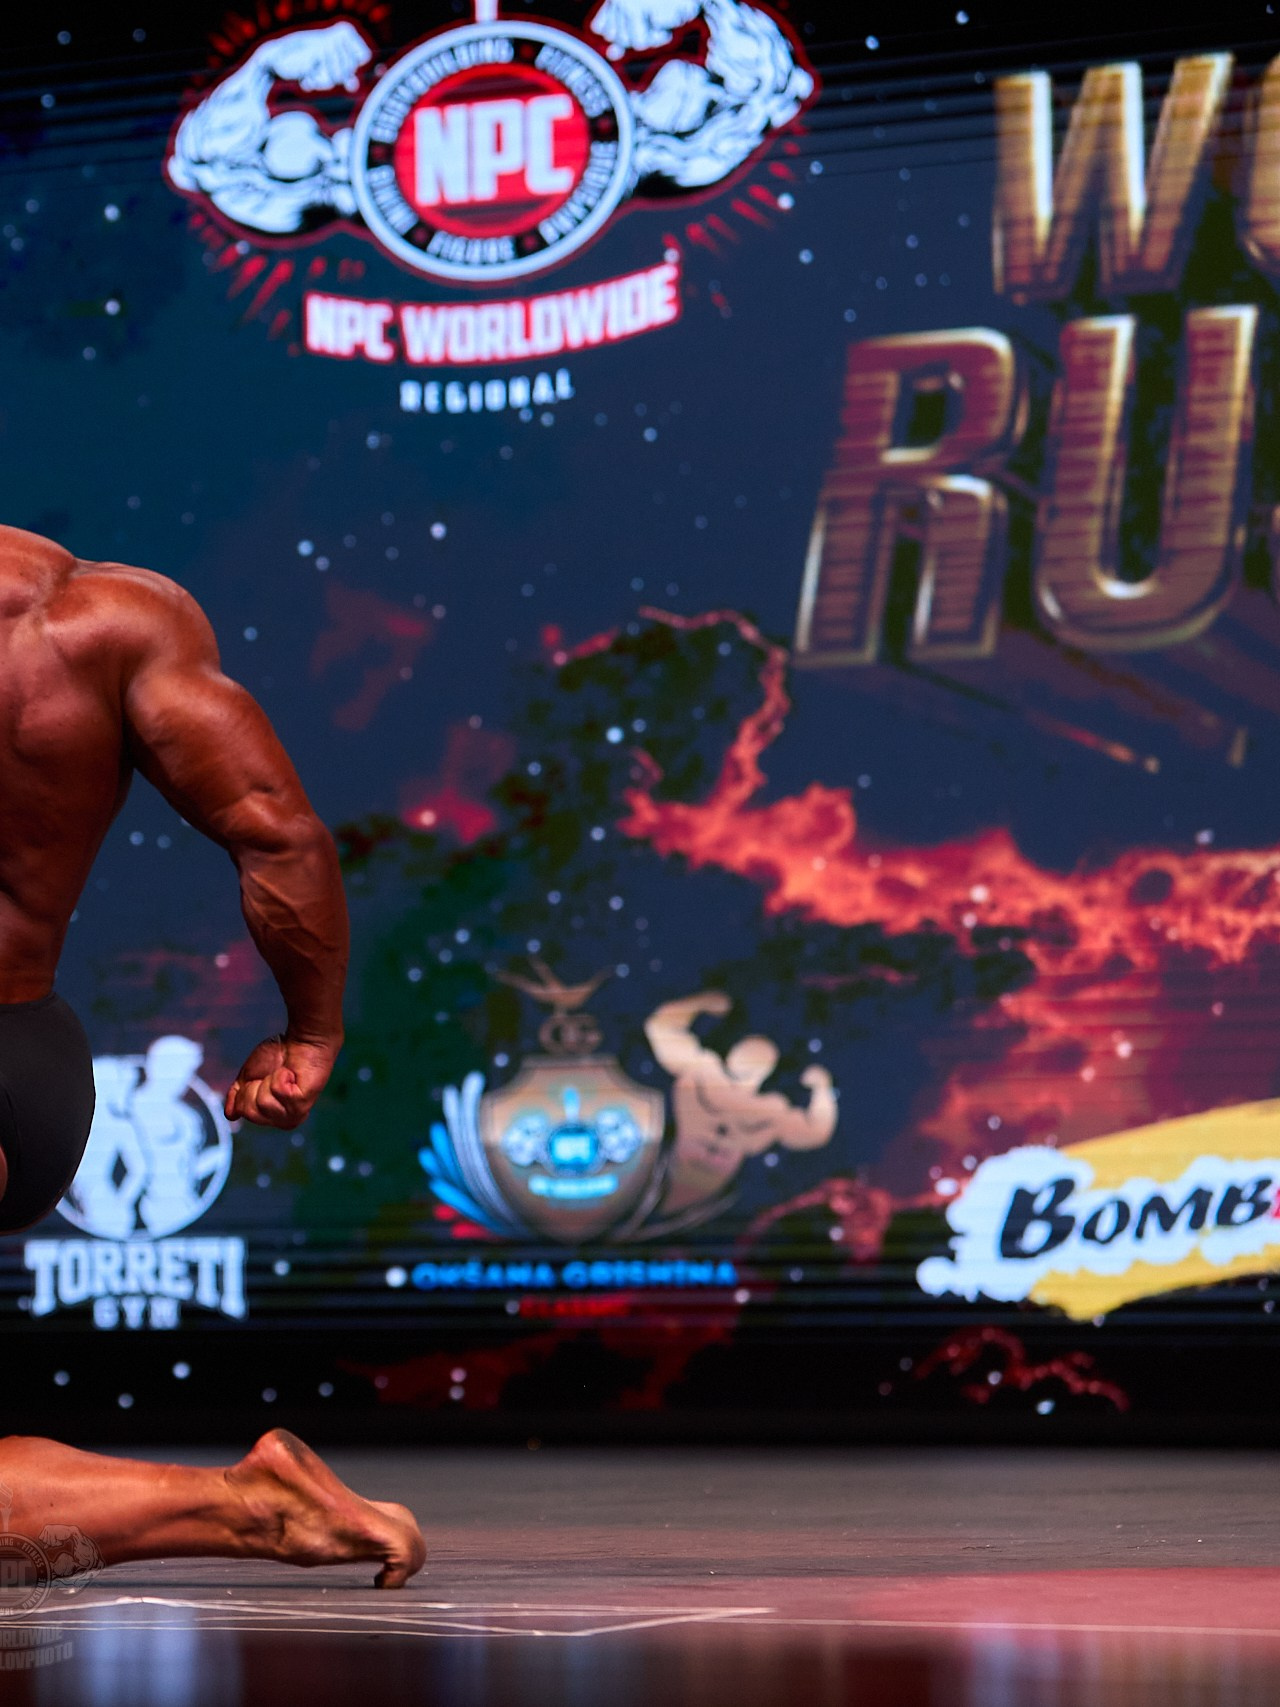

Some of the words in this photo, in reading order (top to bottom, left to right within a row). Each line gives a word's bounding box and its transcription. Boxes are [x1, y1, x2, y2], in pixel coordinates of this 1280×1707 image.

[415, 93, 574, 207] NPC
[305, 294, 395, 363] NPC
[401, 264, 679, 364] WORLDWIDE
[399, 367, 575, 414] REGIONAL
[793, 304, 1280, 668] RU
[999, 1177, 1280, 1259] BOMB
[24, 1237, 245, 1320] TORRETI
[93, 1297, 181, 1329] GYM
